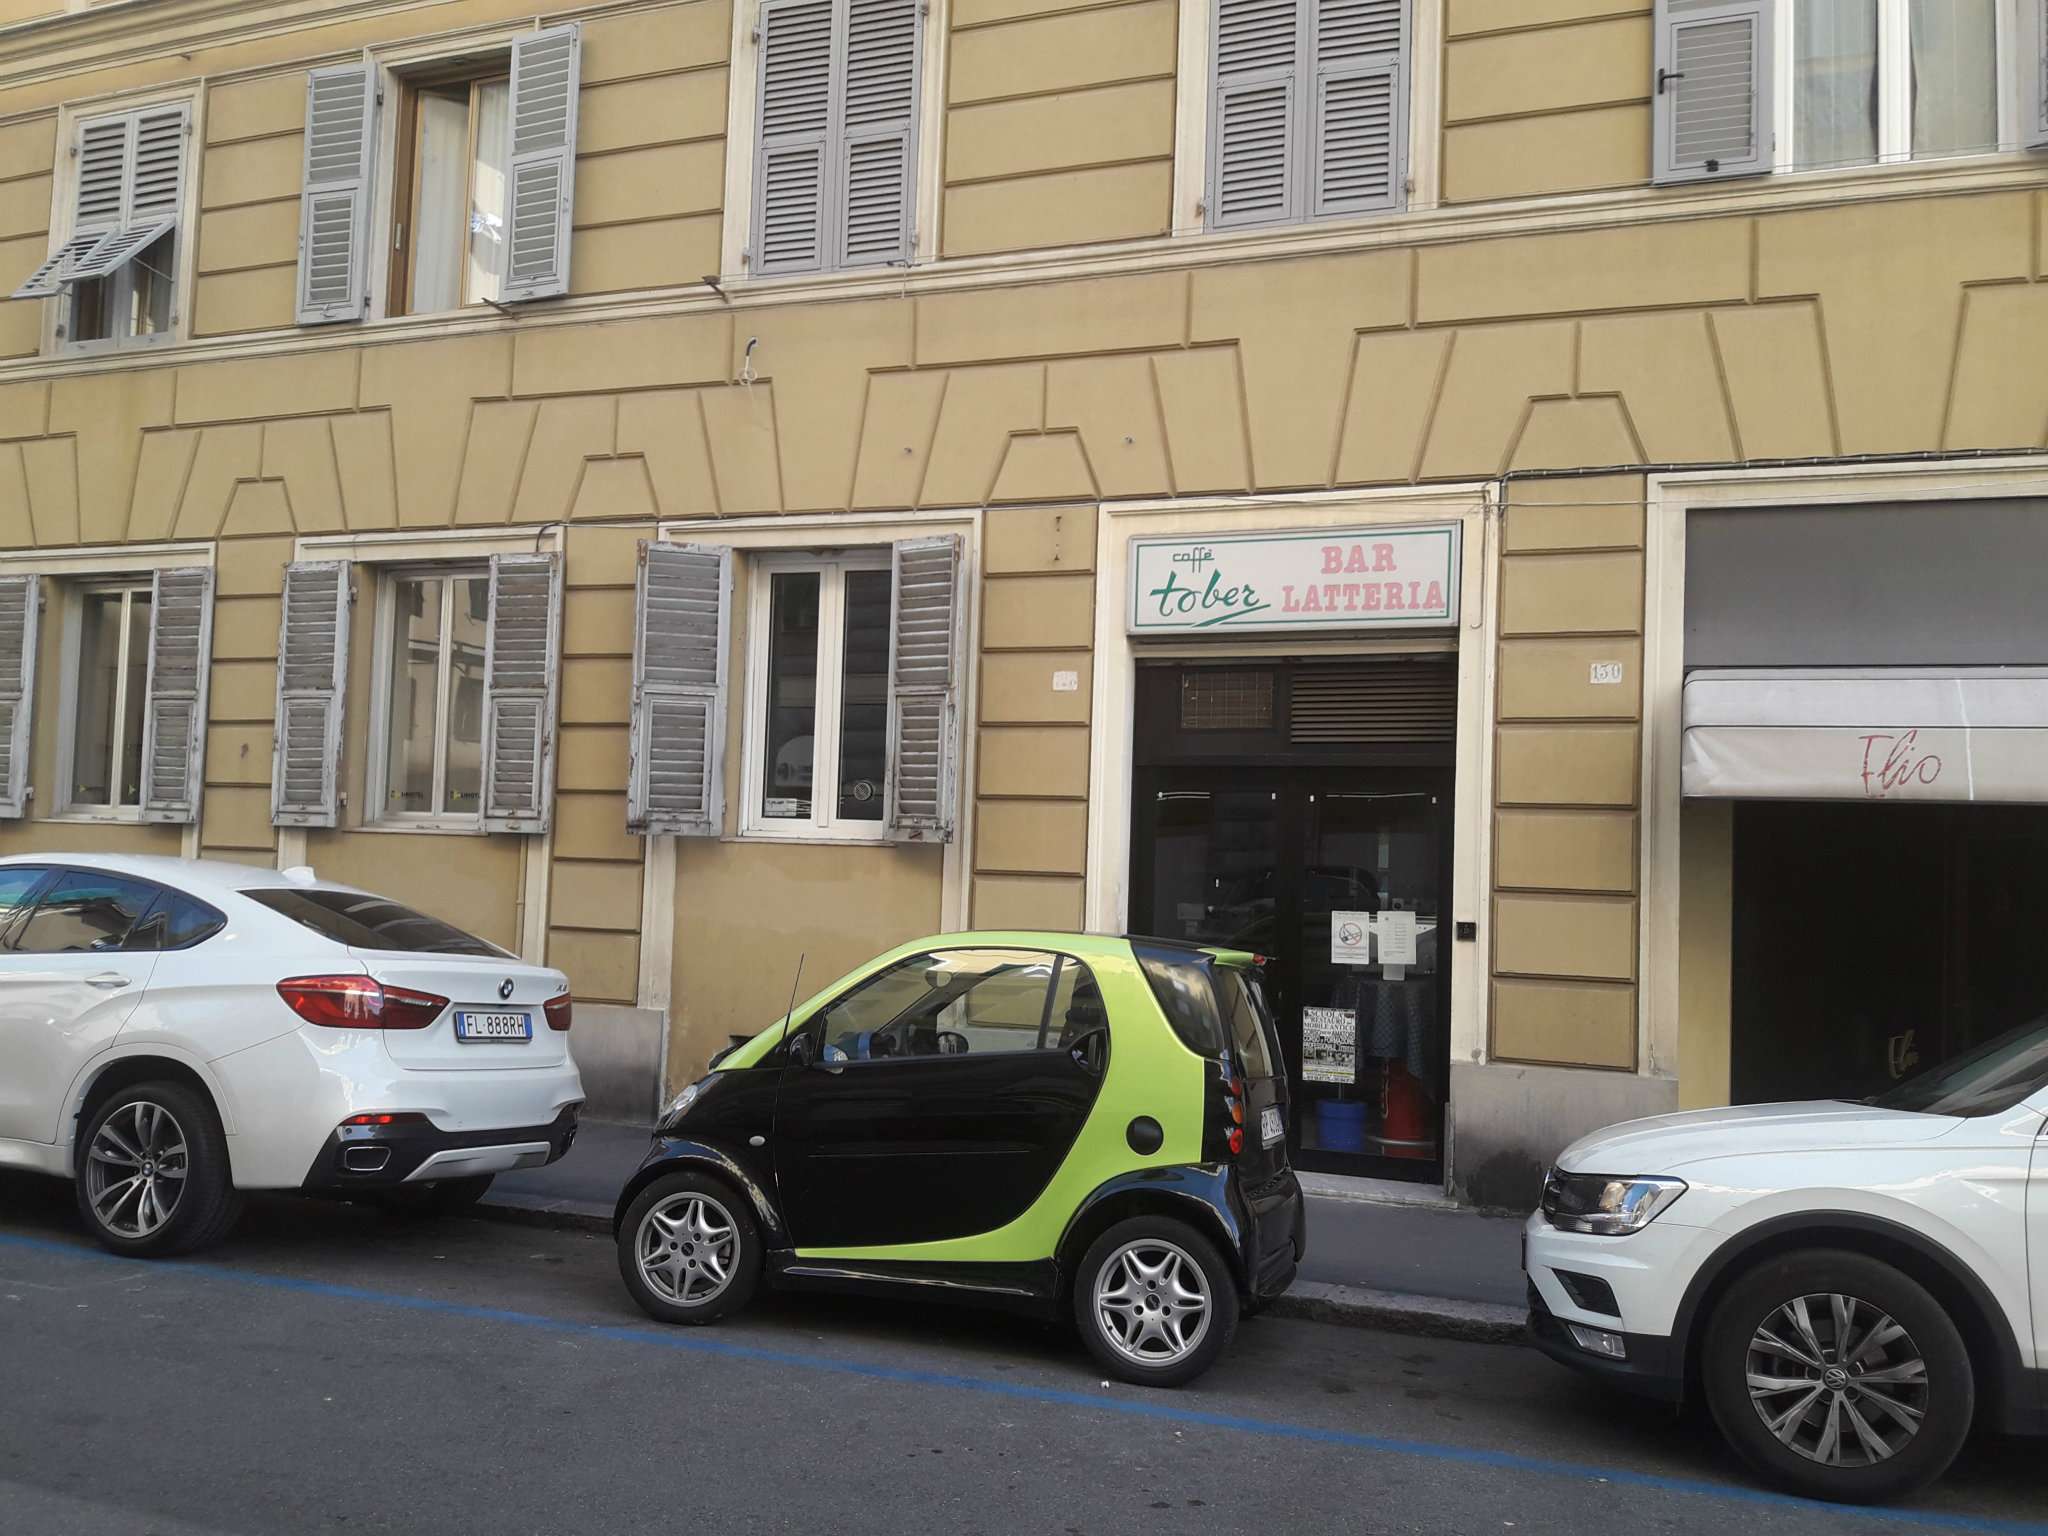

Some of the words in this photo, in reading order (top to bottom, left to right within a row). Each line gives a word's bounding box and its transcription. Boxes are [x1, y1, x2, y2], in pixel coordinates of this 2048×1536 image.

[1321, 543, 1397, 574] BAR
[1150, 568, 1262, 618] tober
[1281, 580, 1446, 613] LATTERIA
[466, 1015, 482, 1034] FL
[486, 1015, 525, 1035] 888RH
